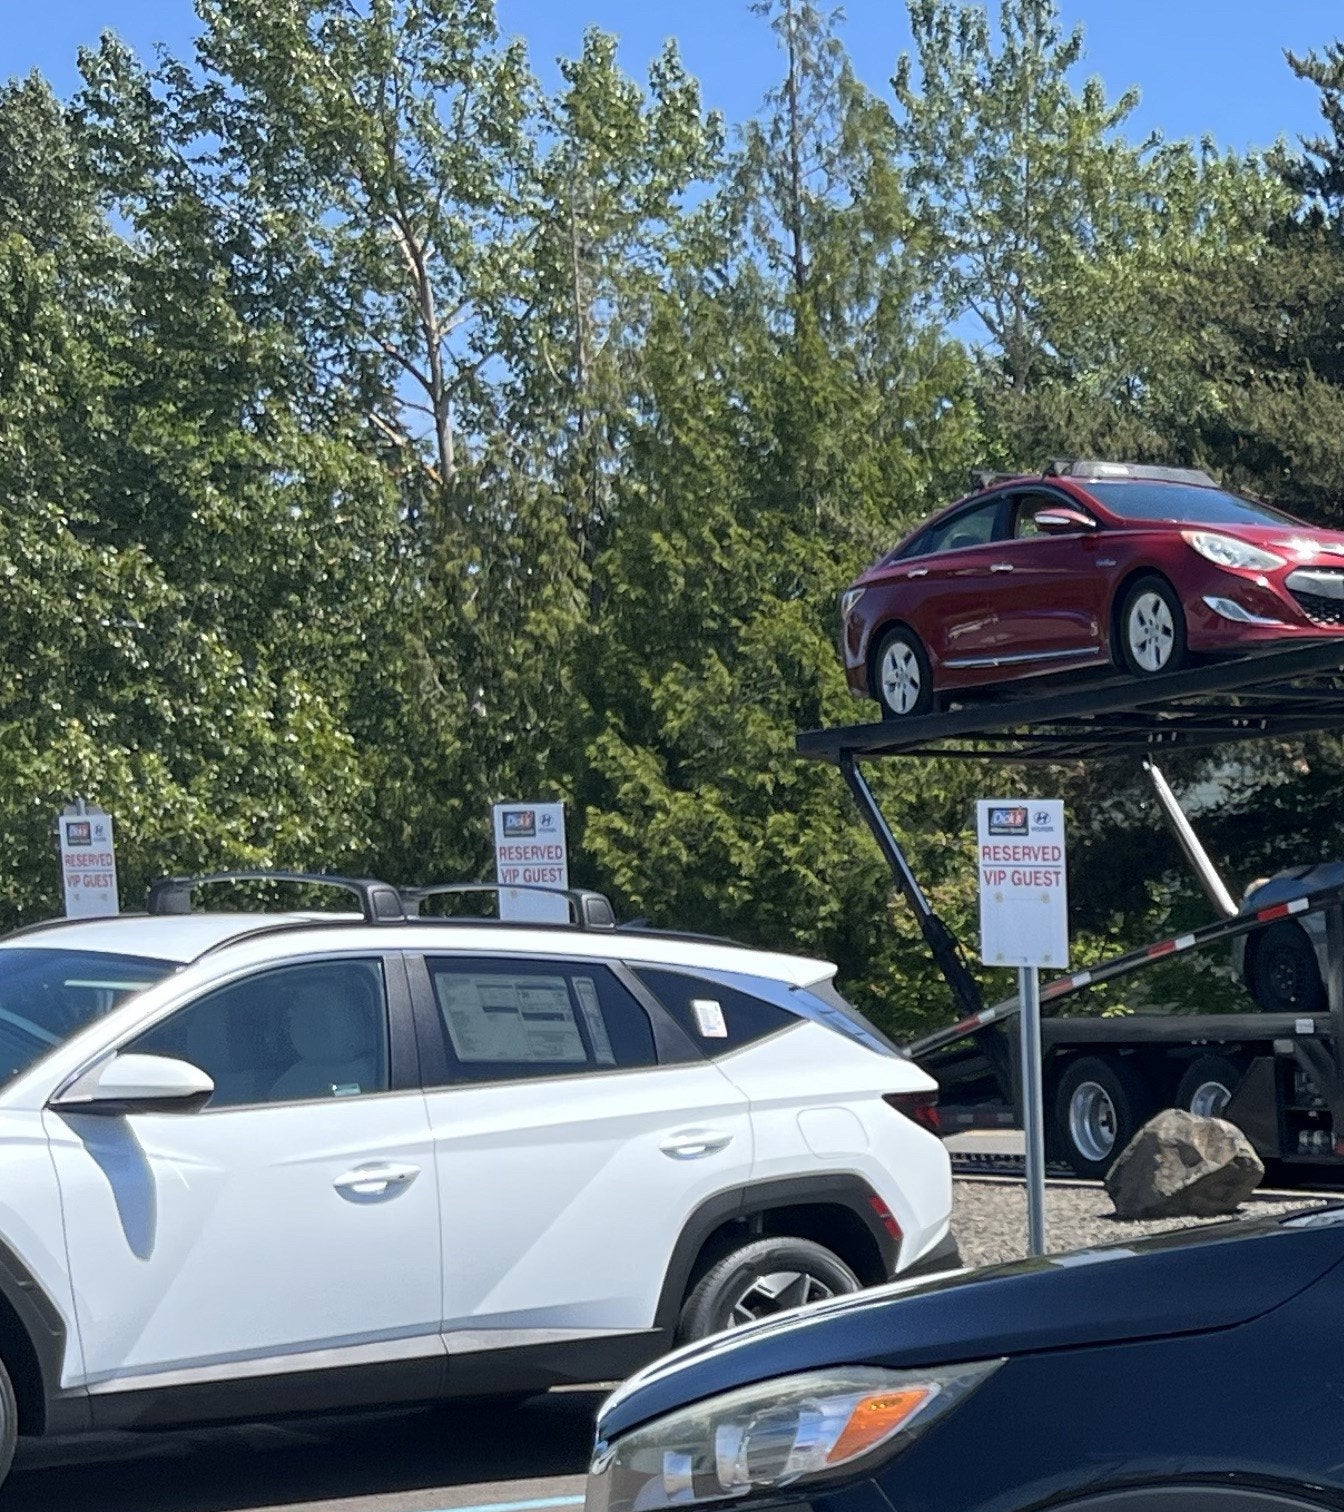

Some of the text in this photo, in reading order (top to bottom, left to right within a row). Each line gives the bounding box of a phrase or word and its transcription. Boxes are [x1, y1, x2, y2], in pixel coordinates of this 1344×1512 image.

[65, 853, 113, 867] RESERVED
[499, 845, 563, 860] RESERVED
[982, 846, 1061, 861] RESERVED
[83, 874, 113, 888] GUEST
[501, 868, 563, 884] VIP GUEST
[983, 870, 1061, 886] VIP GUEST
